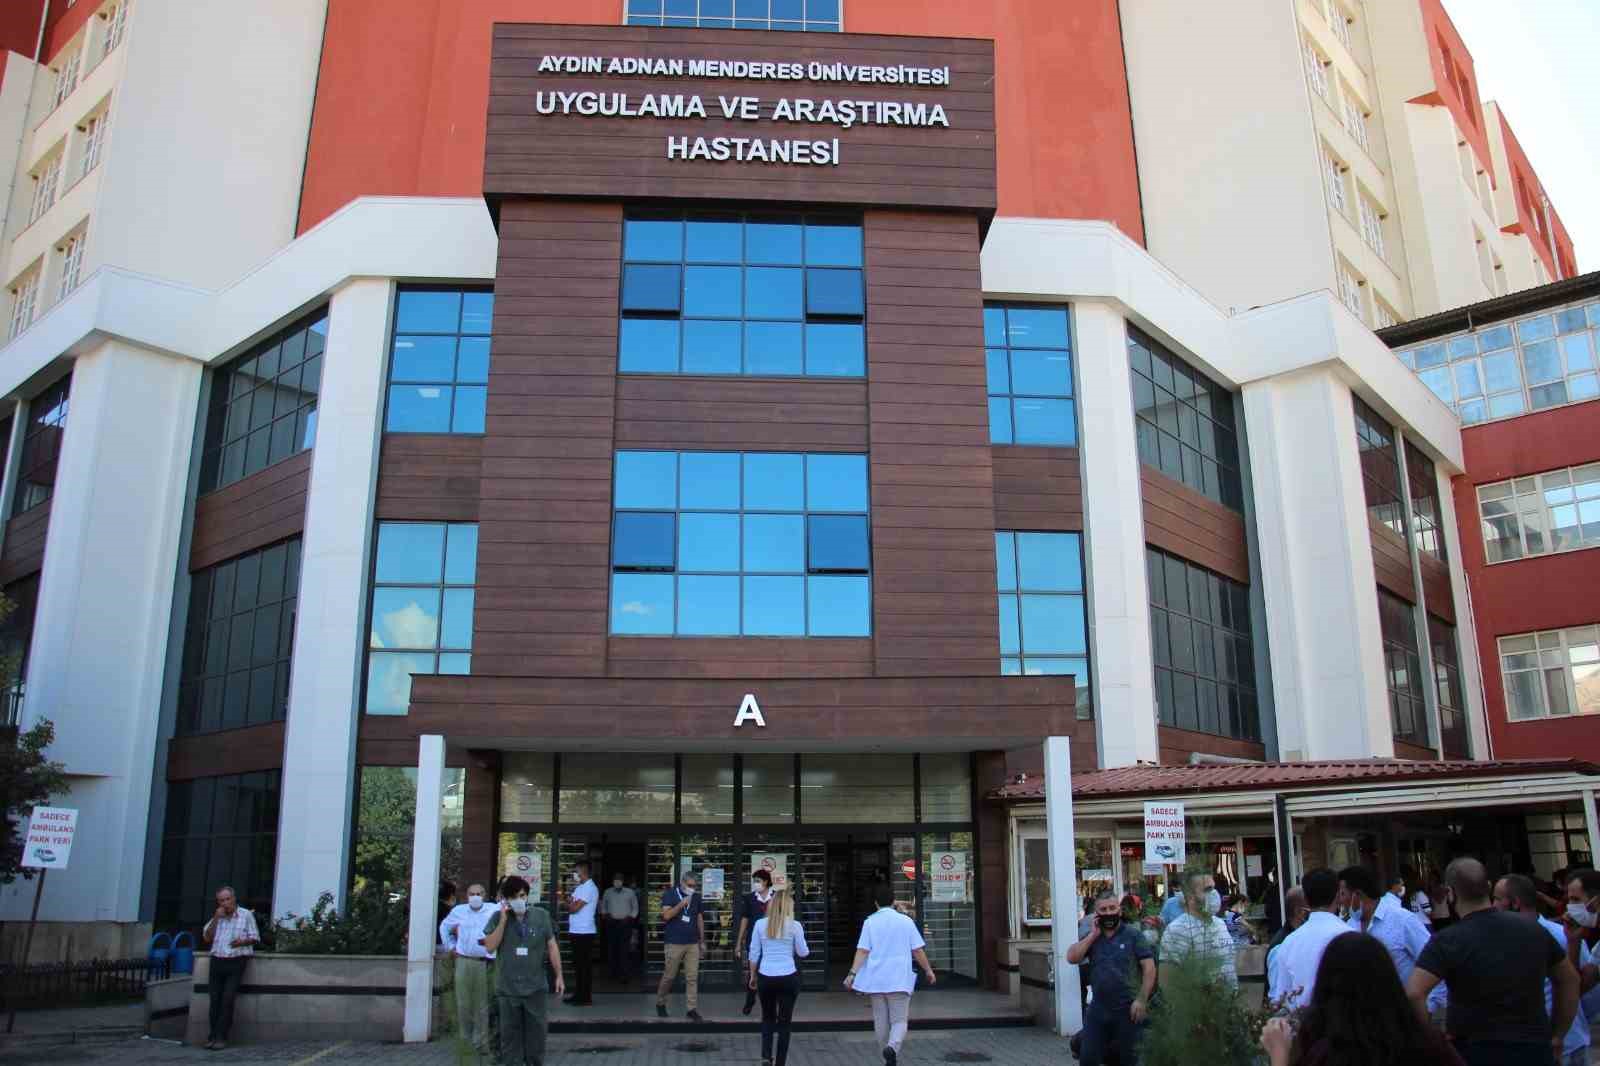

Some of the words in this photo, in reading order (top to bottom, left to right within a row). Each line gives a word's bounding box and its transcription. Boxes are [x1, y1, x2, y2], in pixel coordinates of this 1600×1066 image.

[538, 55, 602, 73] AYDIN
[607, 57, 683, 76] ADNAN
[688, 60, 804, 79] MENDERES
[808, 61, 949, 85] ÜNİVERSİTESİ
[536, 91, 707, 117] UYGULAMA
[719, 96, 759, 119] VE
[772, 98, 950, 128] ARAŞTIRMA
[667, 135, 839, 165] HASTANESİ
[733, 694, 766, 726] A
[1145, 819, 1184, 828] AMBULANS
[1151, 807, 1178, 816] SADECE
[1146, 831, 1165, 840] PARK
